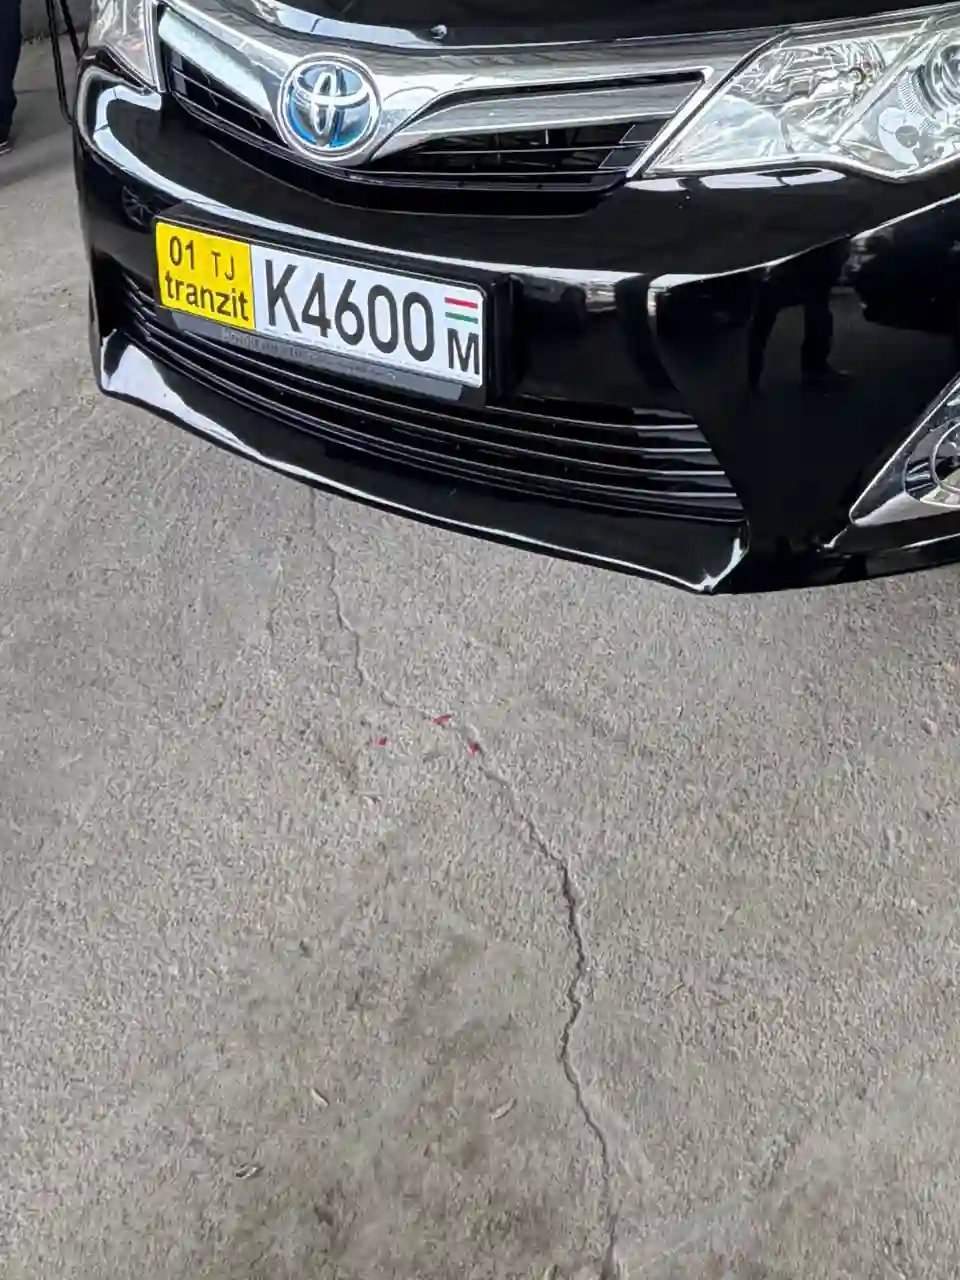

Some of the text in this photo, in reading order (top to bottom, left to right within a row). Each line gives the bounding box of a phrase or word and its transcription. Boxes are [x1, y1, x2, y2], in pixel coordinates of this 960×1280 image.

[169, 235, 195, 270] 01
[164, 270, 250, 322] tranzit
[264, 258, 437, 363] K4600
